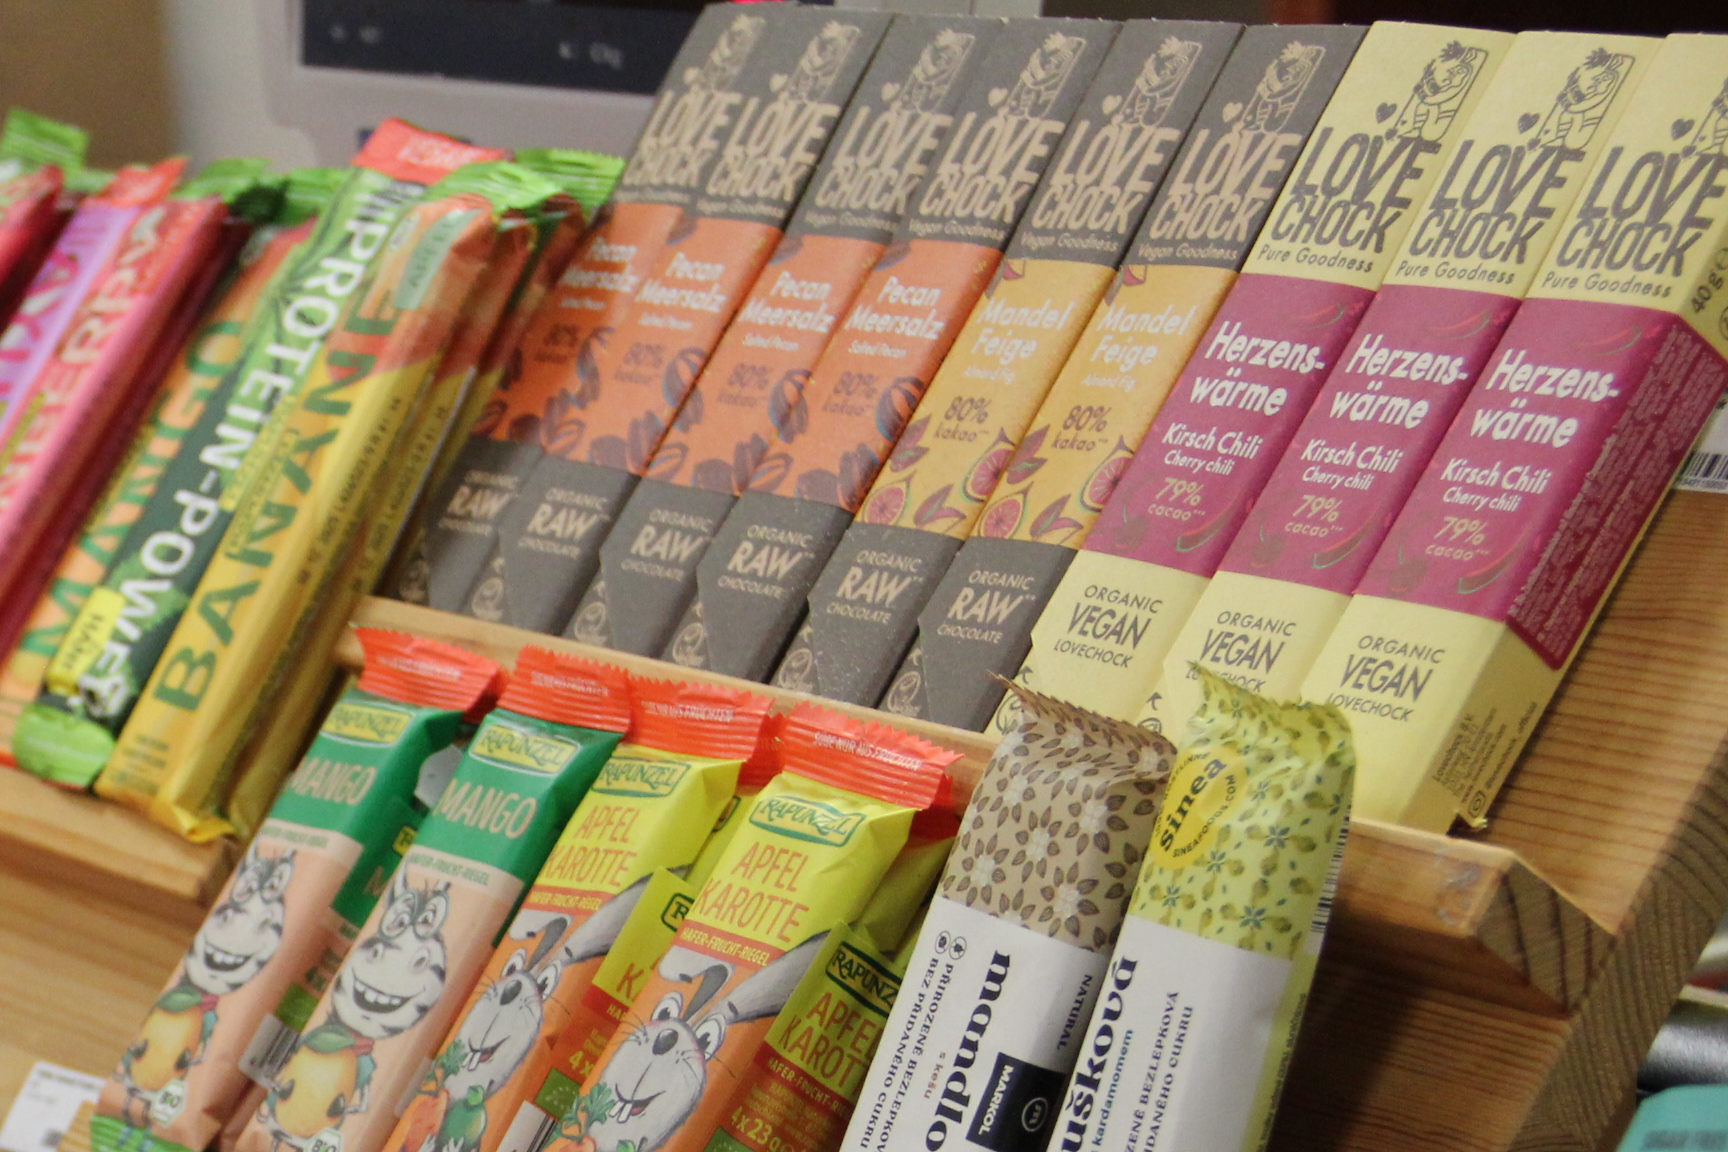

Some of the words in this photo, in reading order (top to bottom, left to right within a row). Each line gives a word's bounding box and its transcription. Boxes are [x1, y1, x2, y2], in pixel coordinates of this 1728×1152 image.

[936, 111, 1066, 184] LOVE
[1050, 119, 1176, 195] LOVE
[1172, 128, 1303, 202] LOVE
[1293, 127, 1442, 209] LOVE
[1430, 139, 1586, 221] LOVE
[918, 173, 1037, 225] CHOCK
[1579, 147, 1728, 230] LOVE
[1030, 183, 1147, 235] CHOCK
[1149, 193, 1264, 243] CHOCK
[1271, 197, 1404, 255] CHOCK
[1408, 209, 1545, 266] CHOCK
[1555, 221, 1704, 278] CHOCK
[665, 252, 725, 282] Pecan
[1258, 244, 1291, 264] Pure
[1295, 249, 1373, 274] Goodness
[1396, 260, 1429, 280] Pure
[1435, 263, 1516, 286] Goodness
[770, 271, 831, 300] Pecan
[877, 277, 941, 306] Pecan
[1542, 271, 1577, 291] Pure
[1584, 274, 1673, 300] Goodness
[737, 299, 836, 333] Meersalz
[844, 305, 946, 340] Meersalz
[977, 298, 1076, 330] Mandel
[1096, 304, 1192, 336] Mandel
[971, 328, 1039, 365] Feige
[1091, 336, 1159, 372] Feige
[1205, 321, 1326, 374] Herzens-
[1345, 333, 1468, 386] Herzens-
[1190, 367, 1288, 417] wärme
[1485, 349, 1619, 402] Herzens-
[944, 397, 993, 424] 80%
[1062, 406, 1111, 433] 80%
[1329, 380, 1429, 430] wärme
[1470, 398, 1578, 448] wärme
[1161, 422, 1213, 454] Kirsch
[1215, 428, 1263, 460] Chili
[1301, 438, 1352, 467] Kirsch
[1355, 442, 1404, 474] Chili
[1164, 450, 1204, 476] Cherry
[1205, 454, 1235, 477] chili
[1302, 467, 1341, 493] Cherry
[1342, 469, 1372, 491] chili
[1440, 458, 1495, 490] Kirsch
[1497, 463, 1552, 495] Chili
[152, 265, 407, 710] BANANE
[1154, 476, 1203, 507] 79%
[1442, 486, 1484, 512] Cherry
[1486, 490, 1520, 512] chili
[526, 504, 588, 538] RAW
[649, 508, 713, 532] ORGANIC
[1292, 493, 1342, 523] 79%
[630, 526, 696, 562] RAW
[747, 524, 814, 549] ORGANIC
[1435, 515, 1487, 547] 79%
[622, 557, 684, 581] CHOCOLATE
[727, 542, 797, 576] RAW
[856, 550, 922, 572] ORGANIC
[717, 574, 784, 598] CHOCOLATE
[836, 566, 907, 606] RAW
[968, 570, 1034, 591] ORGANIC
[1084, 584, 1164, 614] ORGANIC
[827, 603, 892, 624] CHOCOLATE
[946, 587, 1018, 625] RAW
[1216, 610, 1297, 636] ORGANIC
[937, 624, 1003, 644] CHOCOLATE
[1066, 602, 1153, 650] VEGAN
[1053, 638, 1133, 669] LOVECHOCK
[1198, 628, 1285, 675] VEGAN
[1357, 635, 1446, 664] ORGANIC
[1341, 655, 1434, 703] VEGAN
[1325, 693, 1414, 724] LOVECHOCK
[480, 727, 572, 769] RAPUNZEL
[288, 757, 378, 804] MANGO
[600, 762, 678, 792] RAPUNZEL
[439, 779, 538, 839] MANGO
[574, 805, 642, 843] APFEL
[757, 799, 862, 836] RAPUNZEL
[1160, 759, 1227, 852] sinea
[546, 845, 638, 888] KAROTTE
[735, 842, 810, 892] APFEL
[528, 890, 604, 912] HAFER-FRUCHT-RIEGEL
[694, 877, 810, 944] KAROTTE
[679, 926, 772, 967] HAFER-FRUCHT-RIEGEL
[926, 957, 940, 988] BEZ
[912, 963, 954, 1060] PŘIROZENĚ
[1055, 973, 1092, 1052] NATURAL
[881, 991, 927, 1093] PŘIDANÉHO
[1138, 991, 1180, 1102] BEZLEPKOVÁ
[1168, 1005, 1192, 1067] CUKRU
[923, 1062, 947, 1101] kešu
[976, 1063, 1016, 1138] MARKOL
[1091, 1027, 1135, 1147] kardamomem
[859, 1096, 887, 1150] CUKRU
